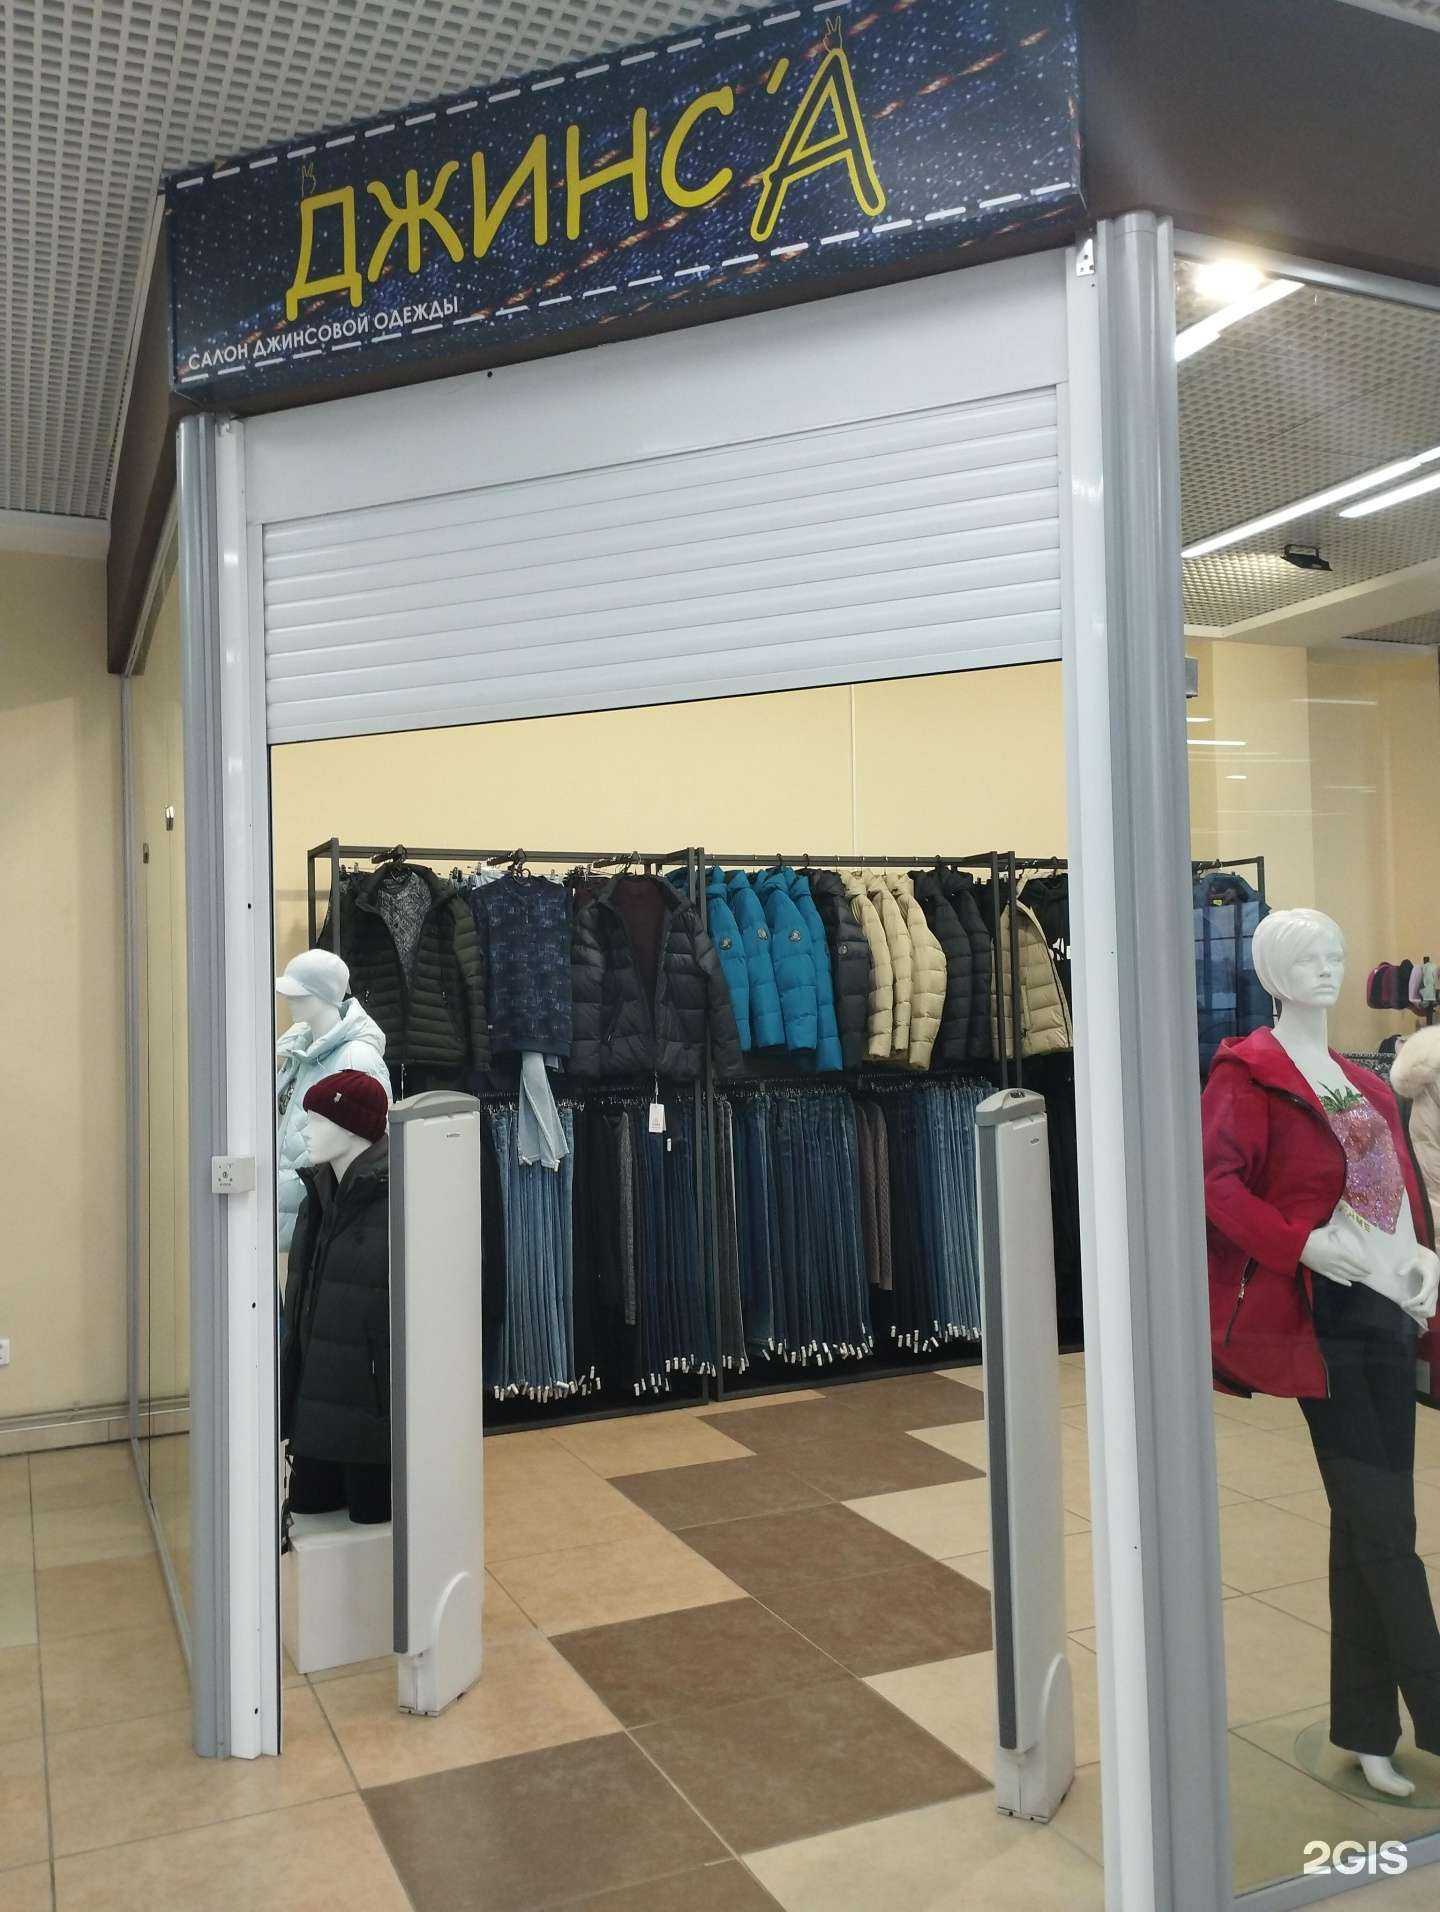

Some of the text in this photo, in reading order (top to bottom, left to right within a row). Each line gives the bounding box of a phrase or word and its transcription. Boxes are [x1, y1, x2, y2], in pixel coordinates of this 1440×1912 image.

[188, 296, 459, 370] САЛОН ДЖИНСОВОЙ ОДЕЖДЫ
